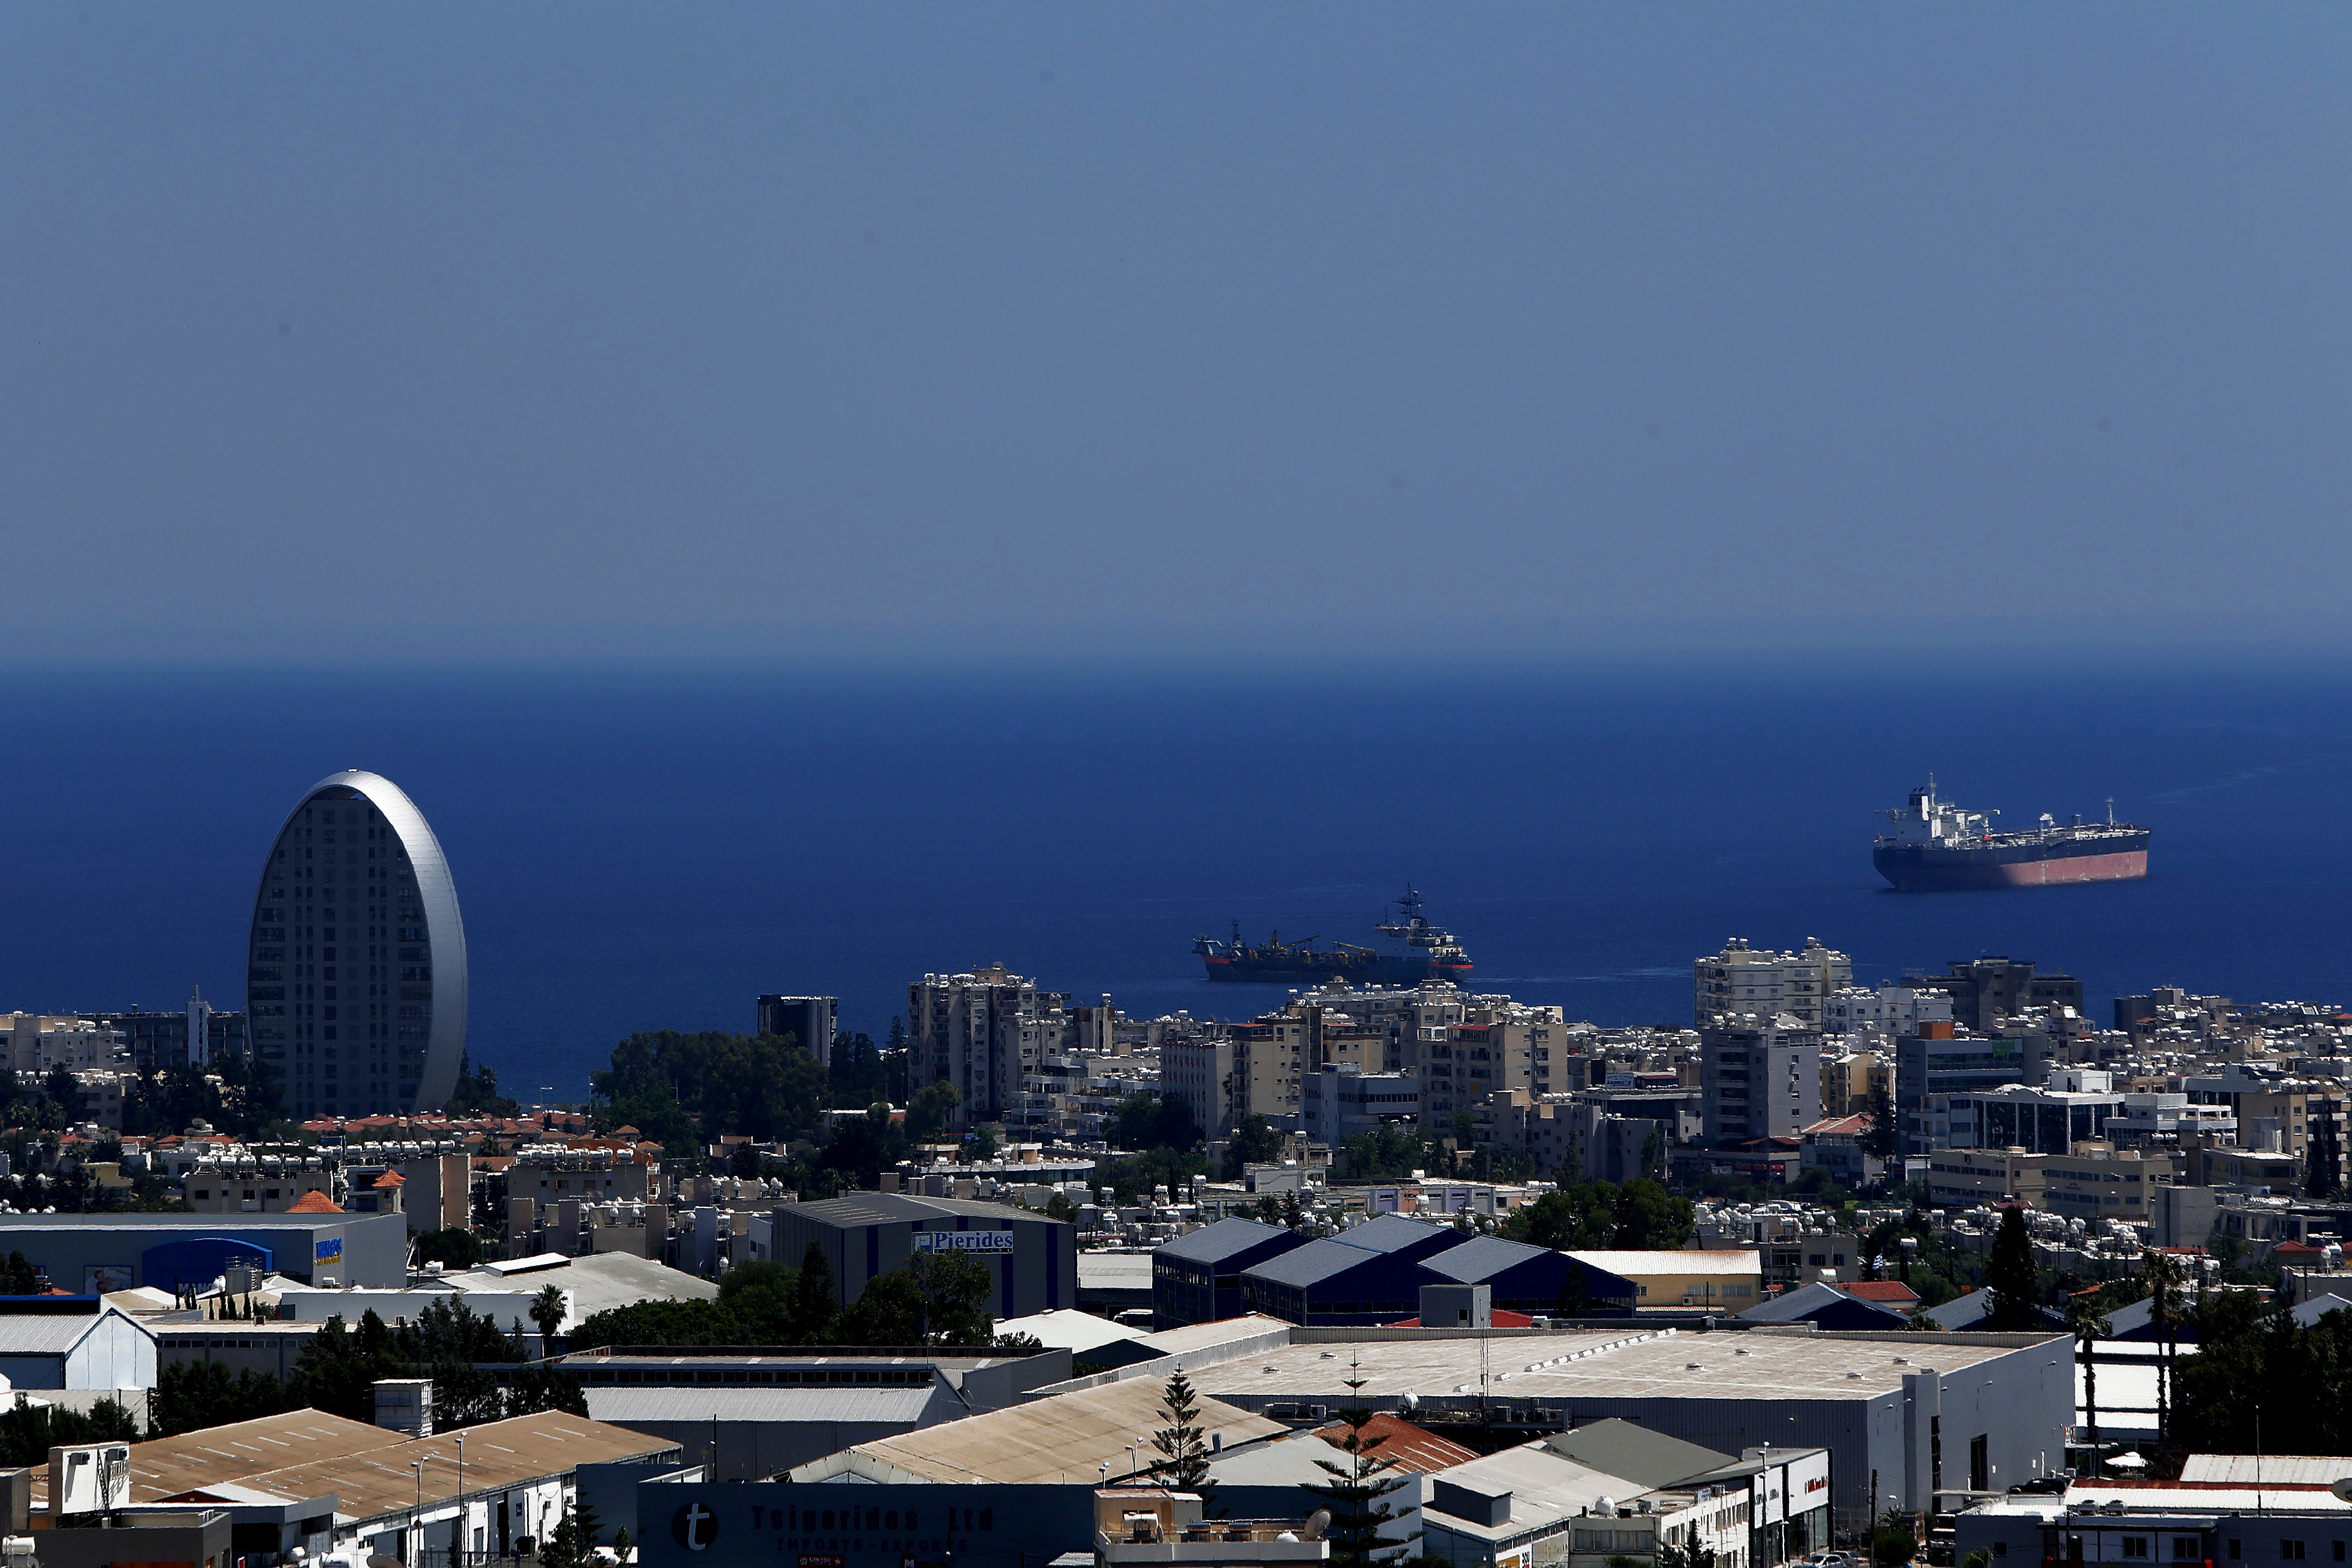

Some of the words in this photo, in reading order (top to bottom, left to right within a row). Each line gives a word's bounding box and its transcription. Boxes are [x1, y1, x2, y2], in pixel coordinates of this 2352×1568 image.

[934, 1232, 1013, 1248] Pierides
[948, 1506, 993, 1531] Ltd
[777, 1538, 863, 1552] IMPORTS
